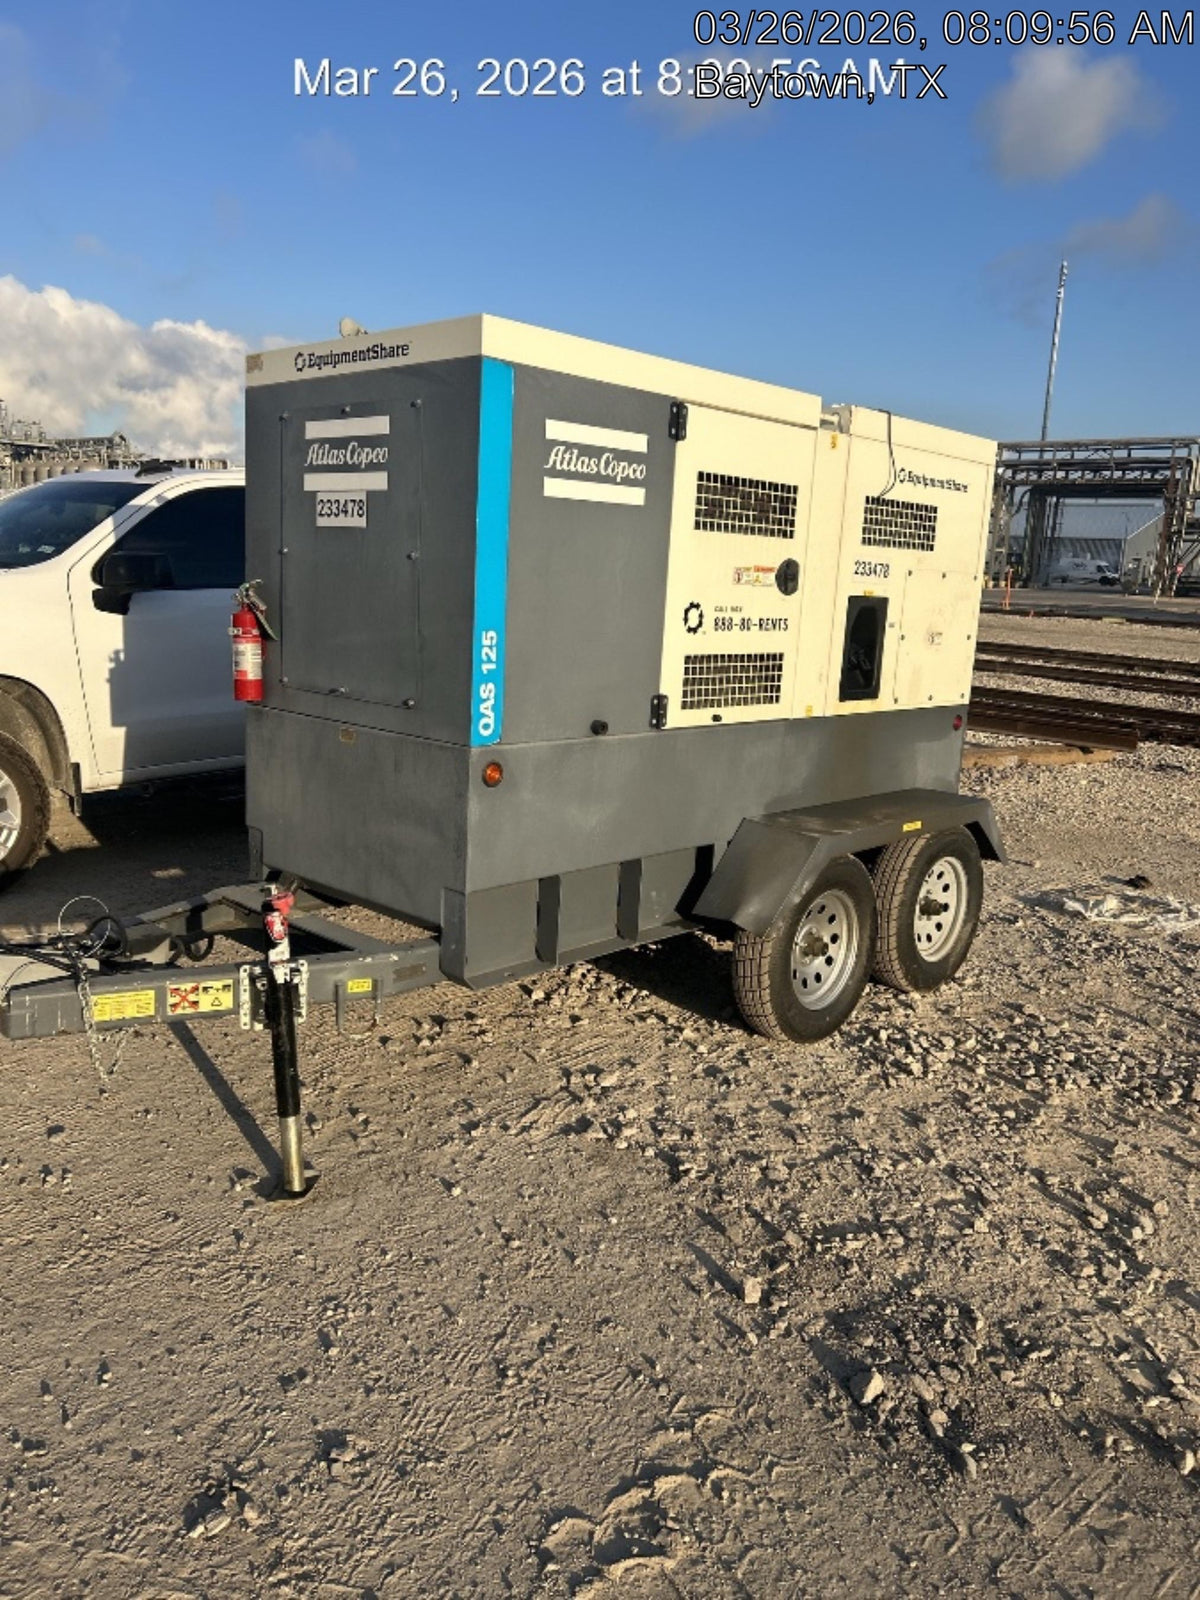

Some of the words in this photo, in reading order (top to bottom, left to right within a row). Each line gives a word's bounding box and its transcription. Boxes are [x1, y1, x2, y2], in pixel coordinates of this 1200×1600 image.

[307, 343, 410, 370] EquipmentShare
[304, 442, 346, 467] Atlas
[346, 441, 388, 469] Copco
[544, 445, 599, 474] Atlas
[600, 452, 647, 482] Copco
[318, 498, 365, 518] 233478
[854, 559, 890, 578] 233478
[713, 616, 789, 632] 888-80-RENTS
[481, 630, 498, 675] 125
[478, 682, 496, 737] QAS
